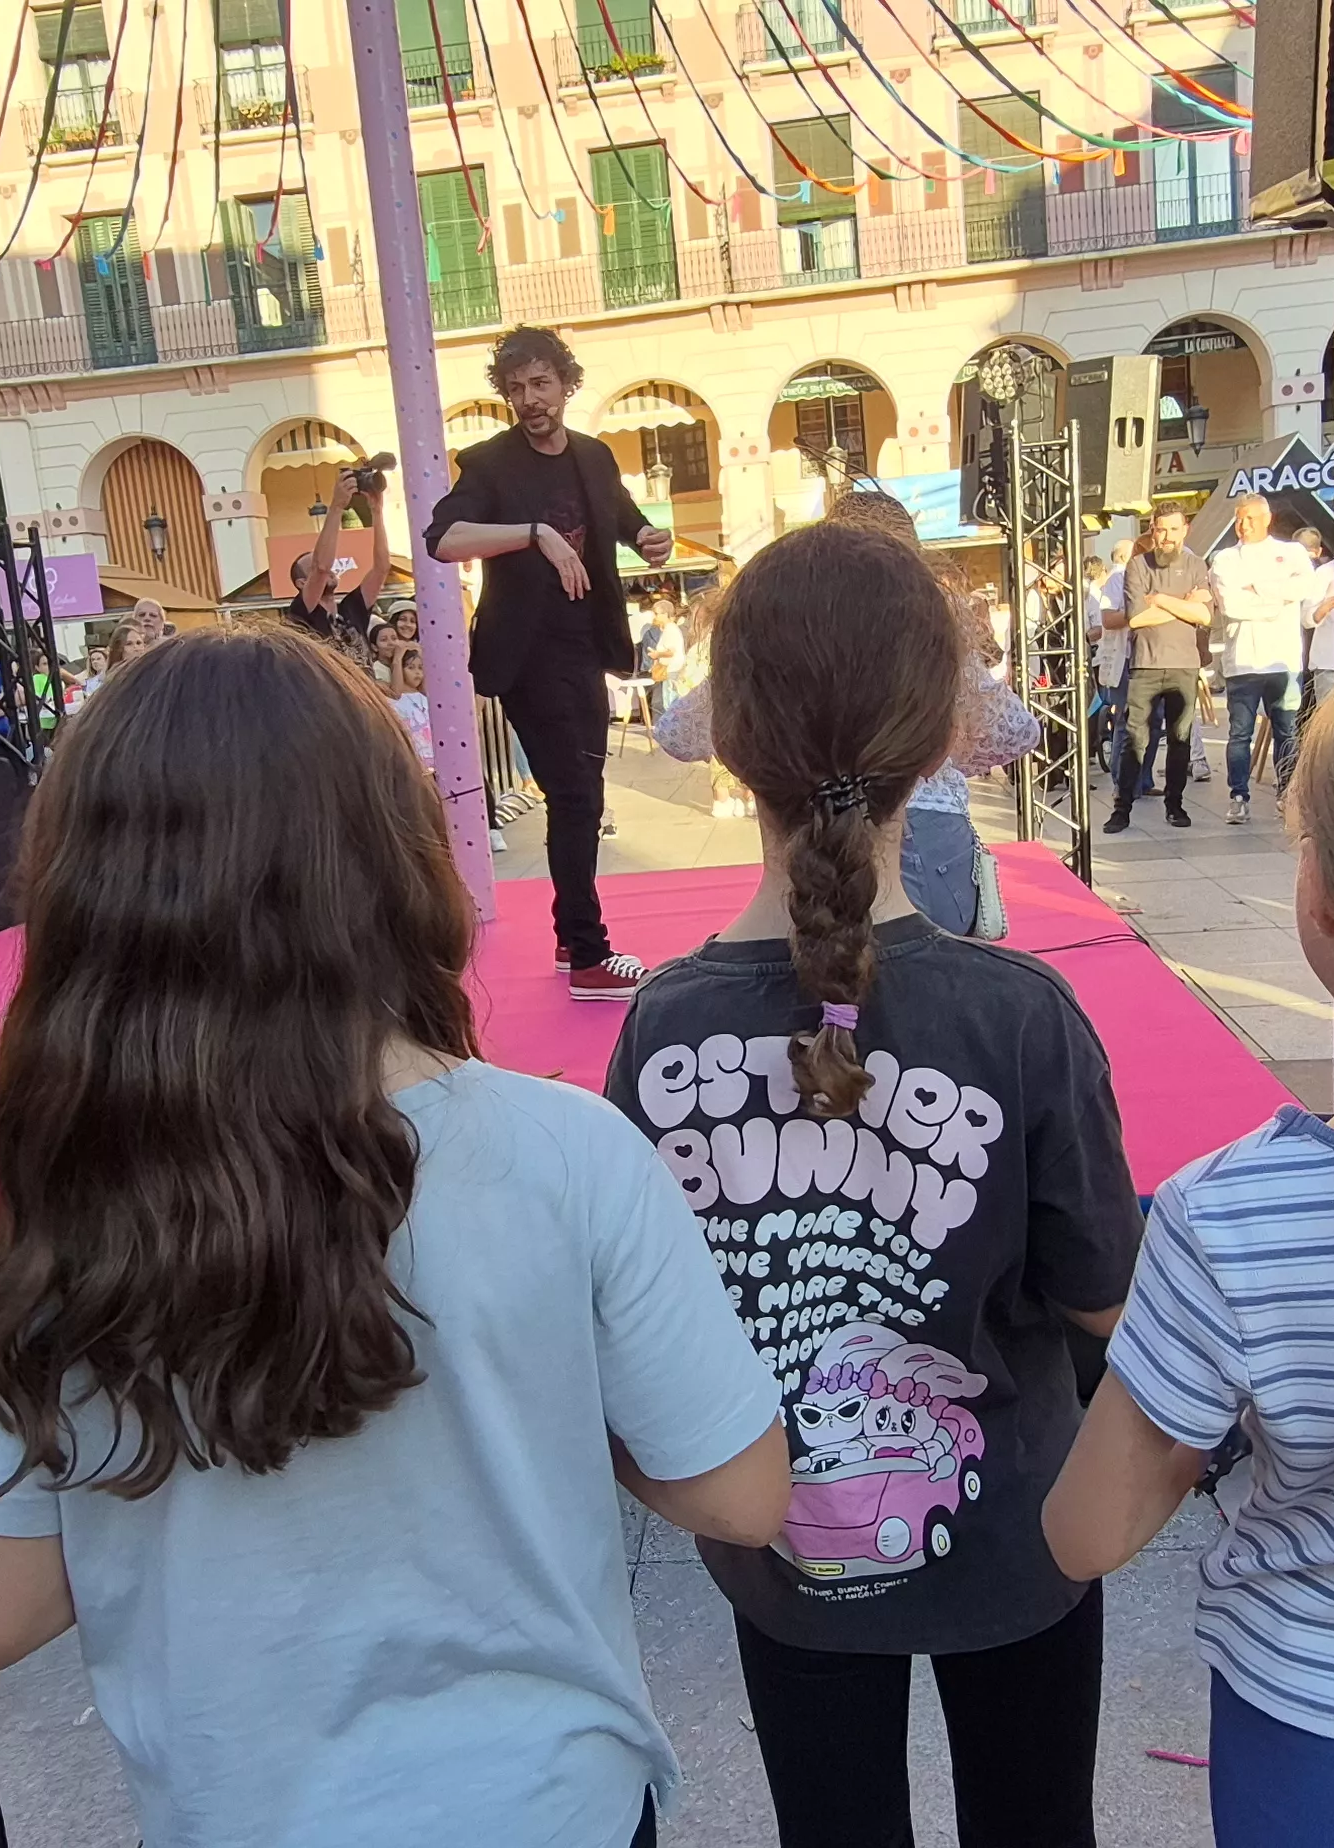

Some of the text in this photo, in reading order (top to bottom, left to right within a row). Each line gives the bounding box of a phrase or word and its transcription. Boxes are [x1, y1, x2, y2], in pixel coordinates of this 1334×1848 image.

[657, 1117, 978, 1250] BUNNY
[712, 1248, 771, 1278] OVE
[754, 1205, 863, 1246] MORE
[869, 1217, 931, 1271] YOU
[757, 1274, 848, 1313] MORE
[856, 1282, 926, 1326] THE
